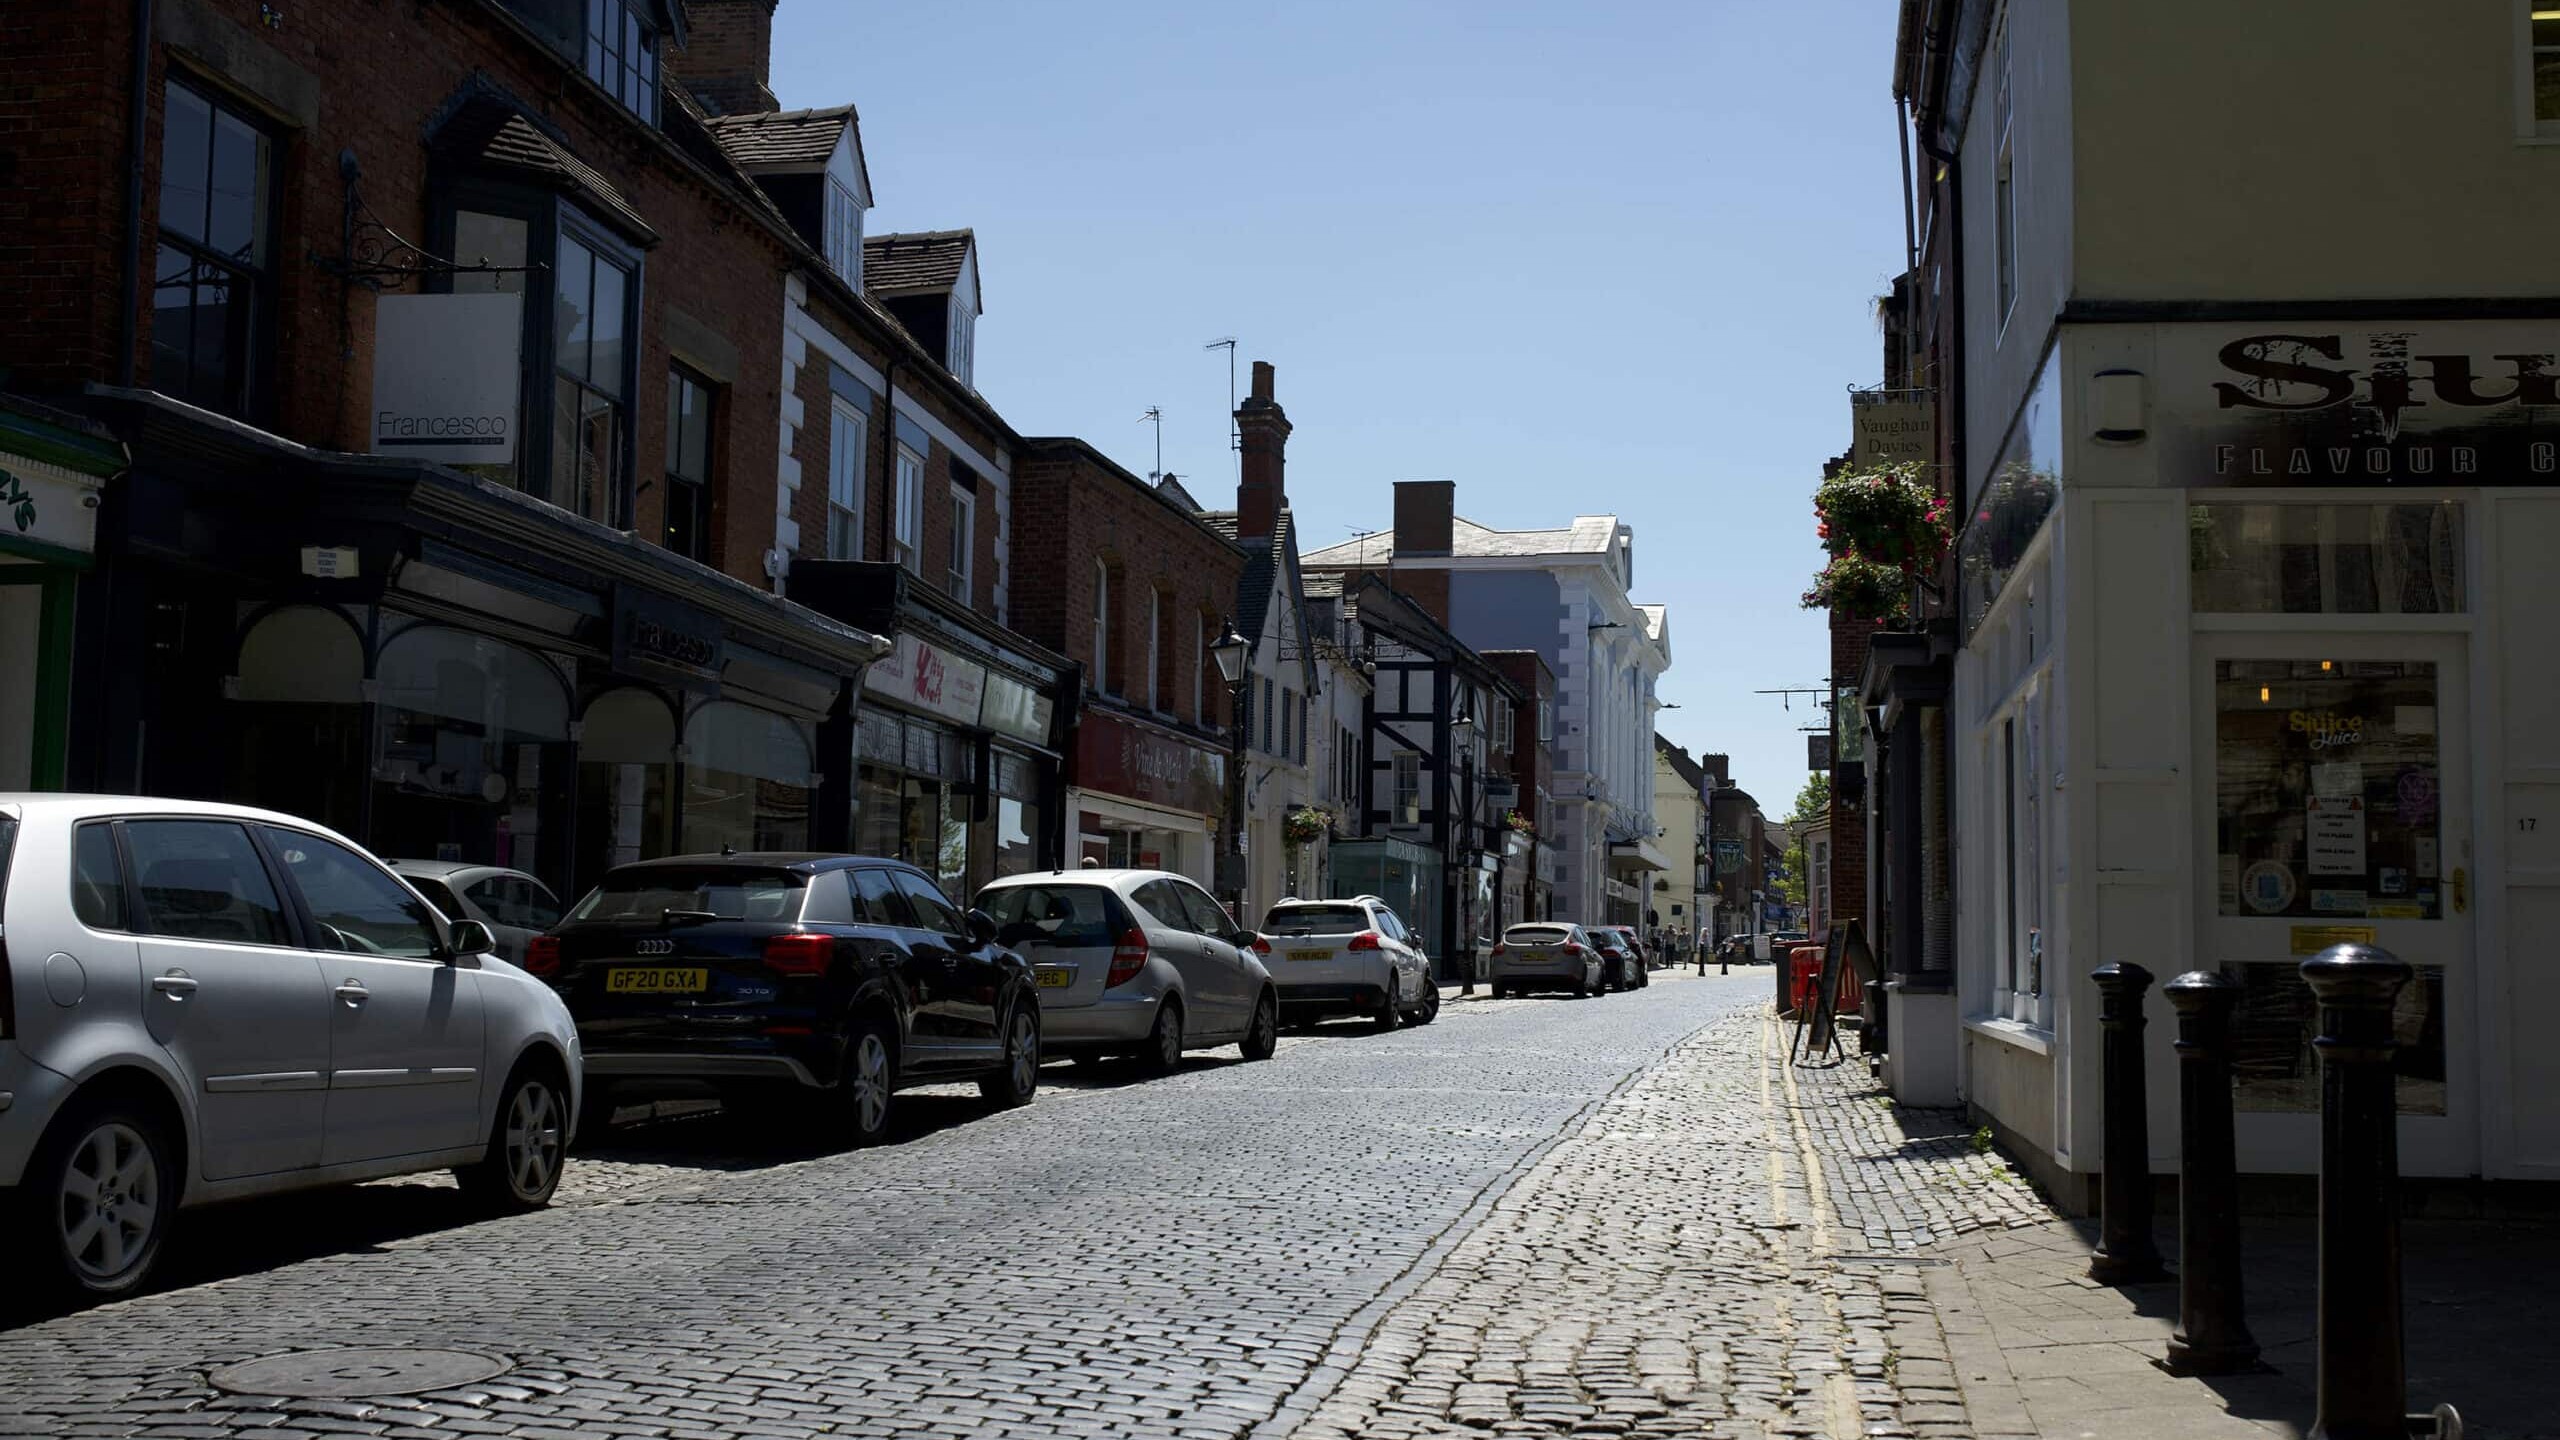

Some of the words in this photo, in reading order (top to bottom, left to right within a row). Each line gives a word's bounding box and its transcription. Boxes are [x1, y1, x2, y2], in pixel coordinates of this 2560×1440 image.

[377, 411, 506, 436] Francesco
[1860, 418, 1929, 435] Vaughan
[1868, 437, 1922, 454] Davies
[2215, 444, 2479, 475] FLAVOUR
[2309, 729, 2362, 750] Juice
[2518, 817, 2537, 831] 17
[614, 971, 659, 988] GF20
[663, 971, 698, 988] GXA
